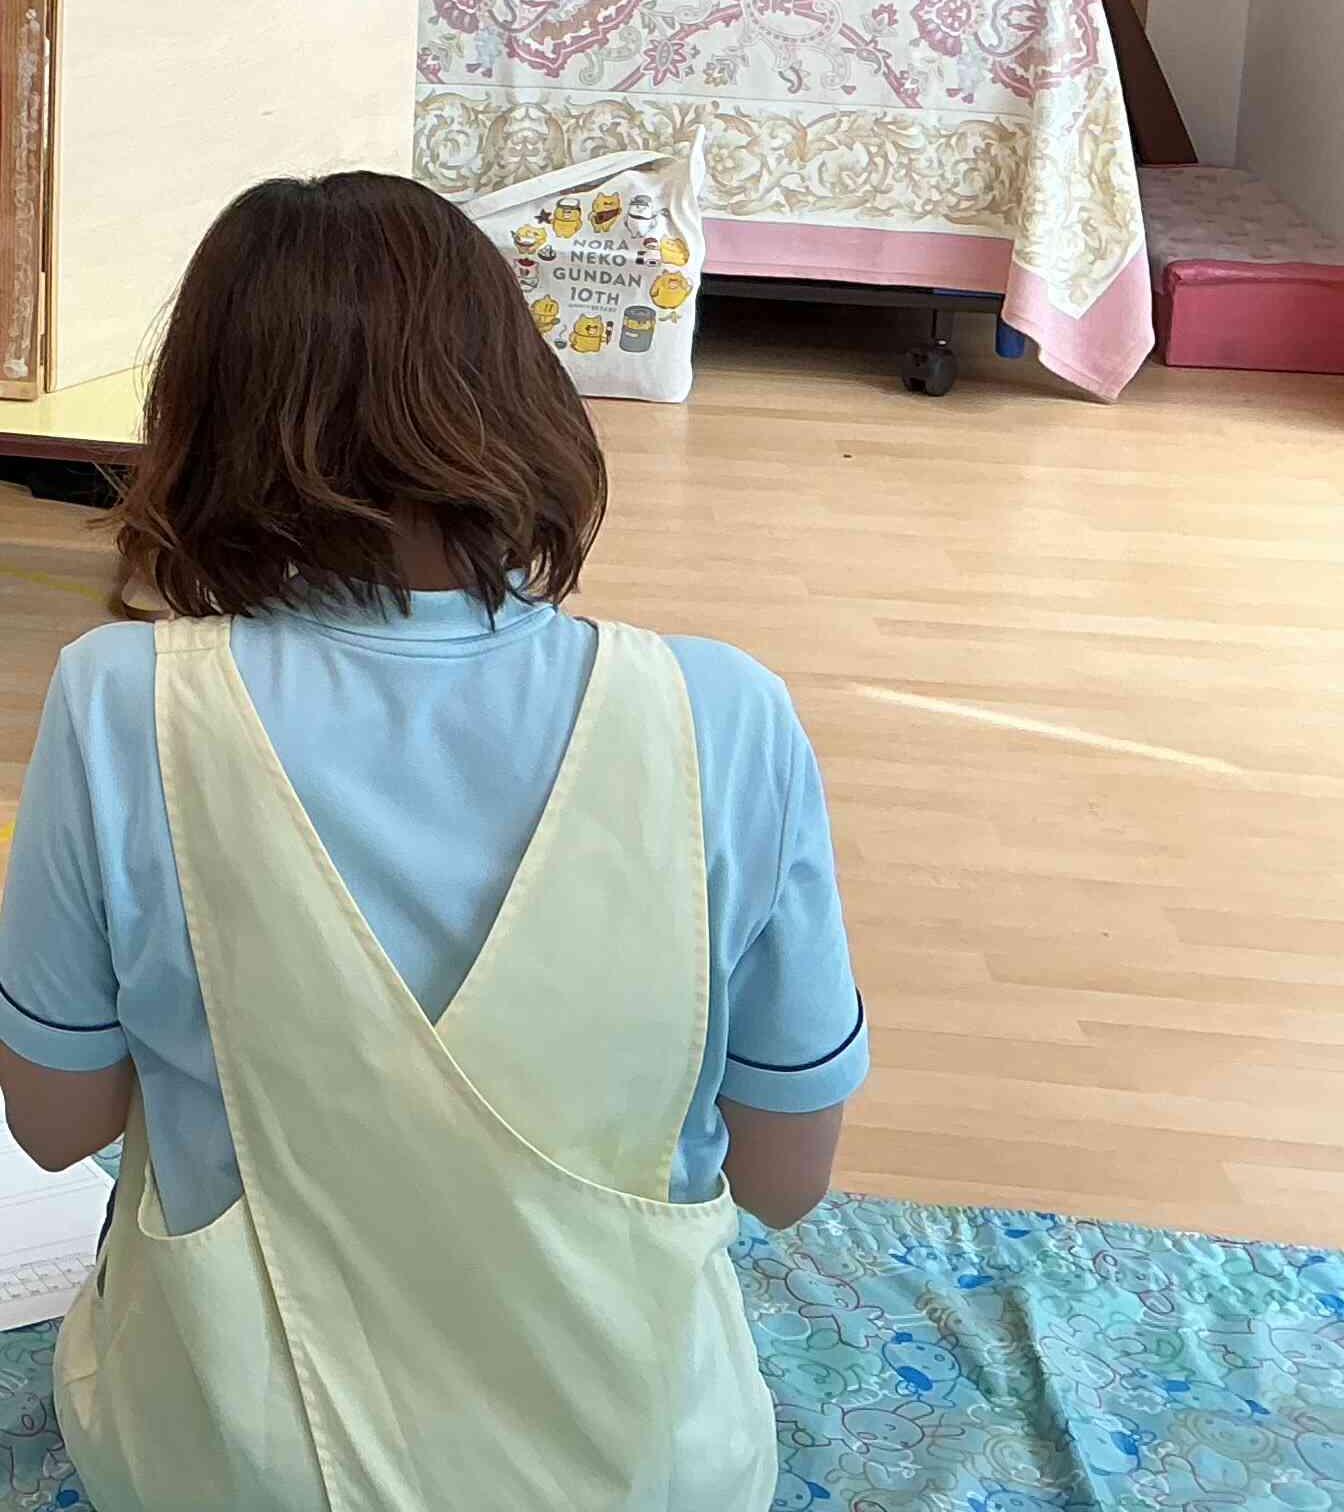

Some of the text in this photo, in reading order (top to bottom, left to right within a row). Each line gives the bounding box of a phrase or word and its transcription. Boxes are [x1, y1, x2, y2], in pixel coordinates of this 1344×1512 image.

[573, 239, 629, 251] NORA
[570, 250, 627, 267] NEKO
[553, 267, 642, 288] GUNDAN
[570, 287, 620, 305] 10TH
